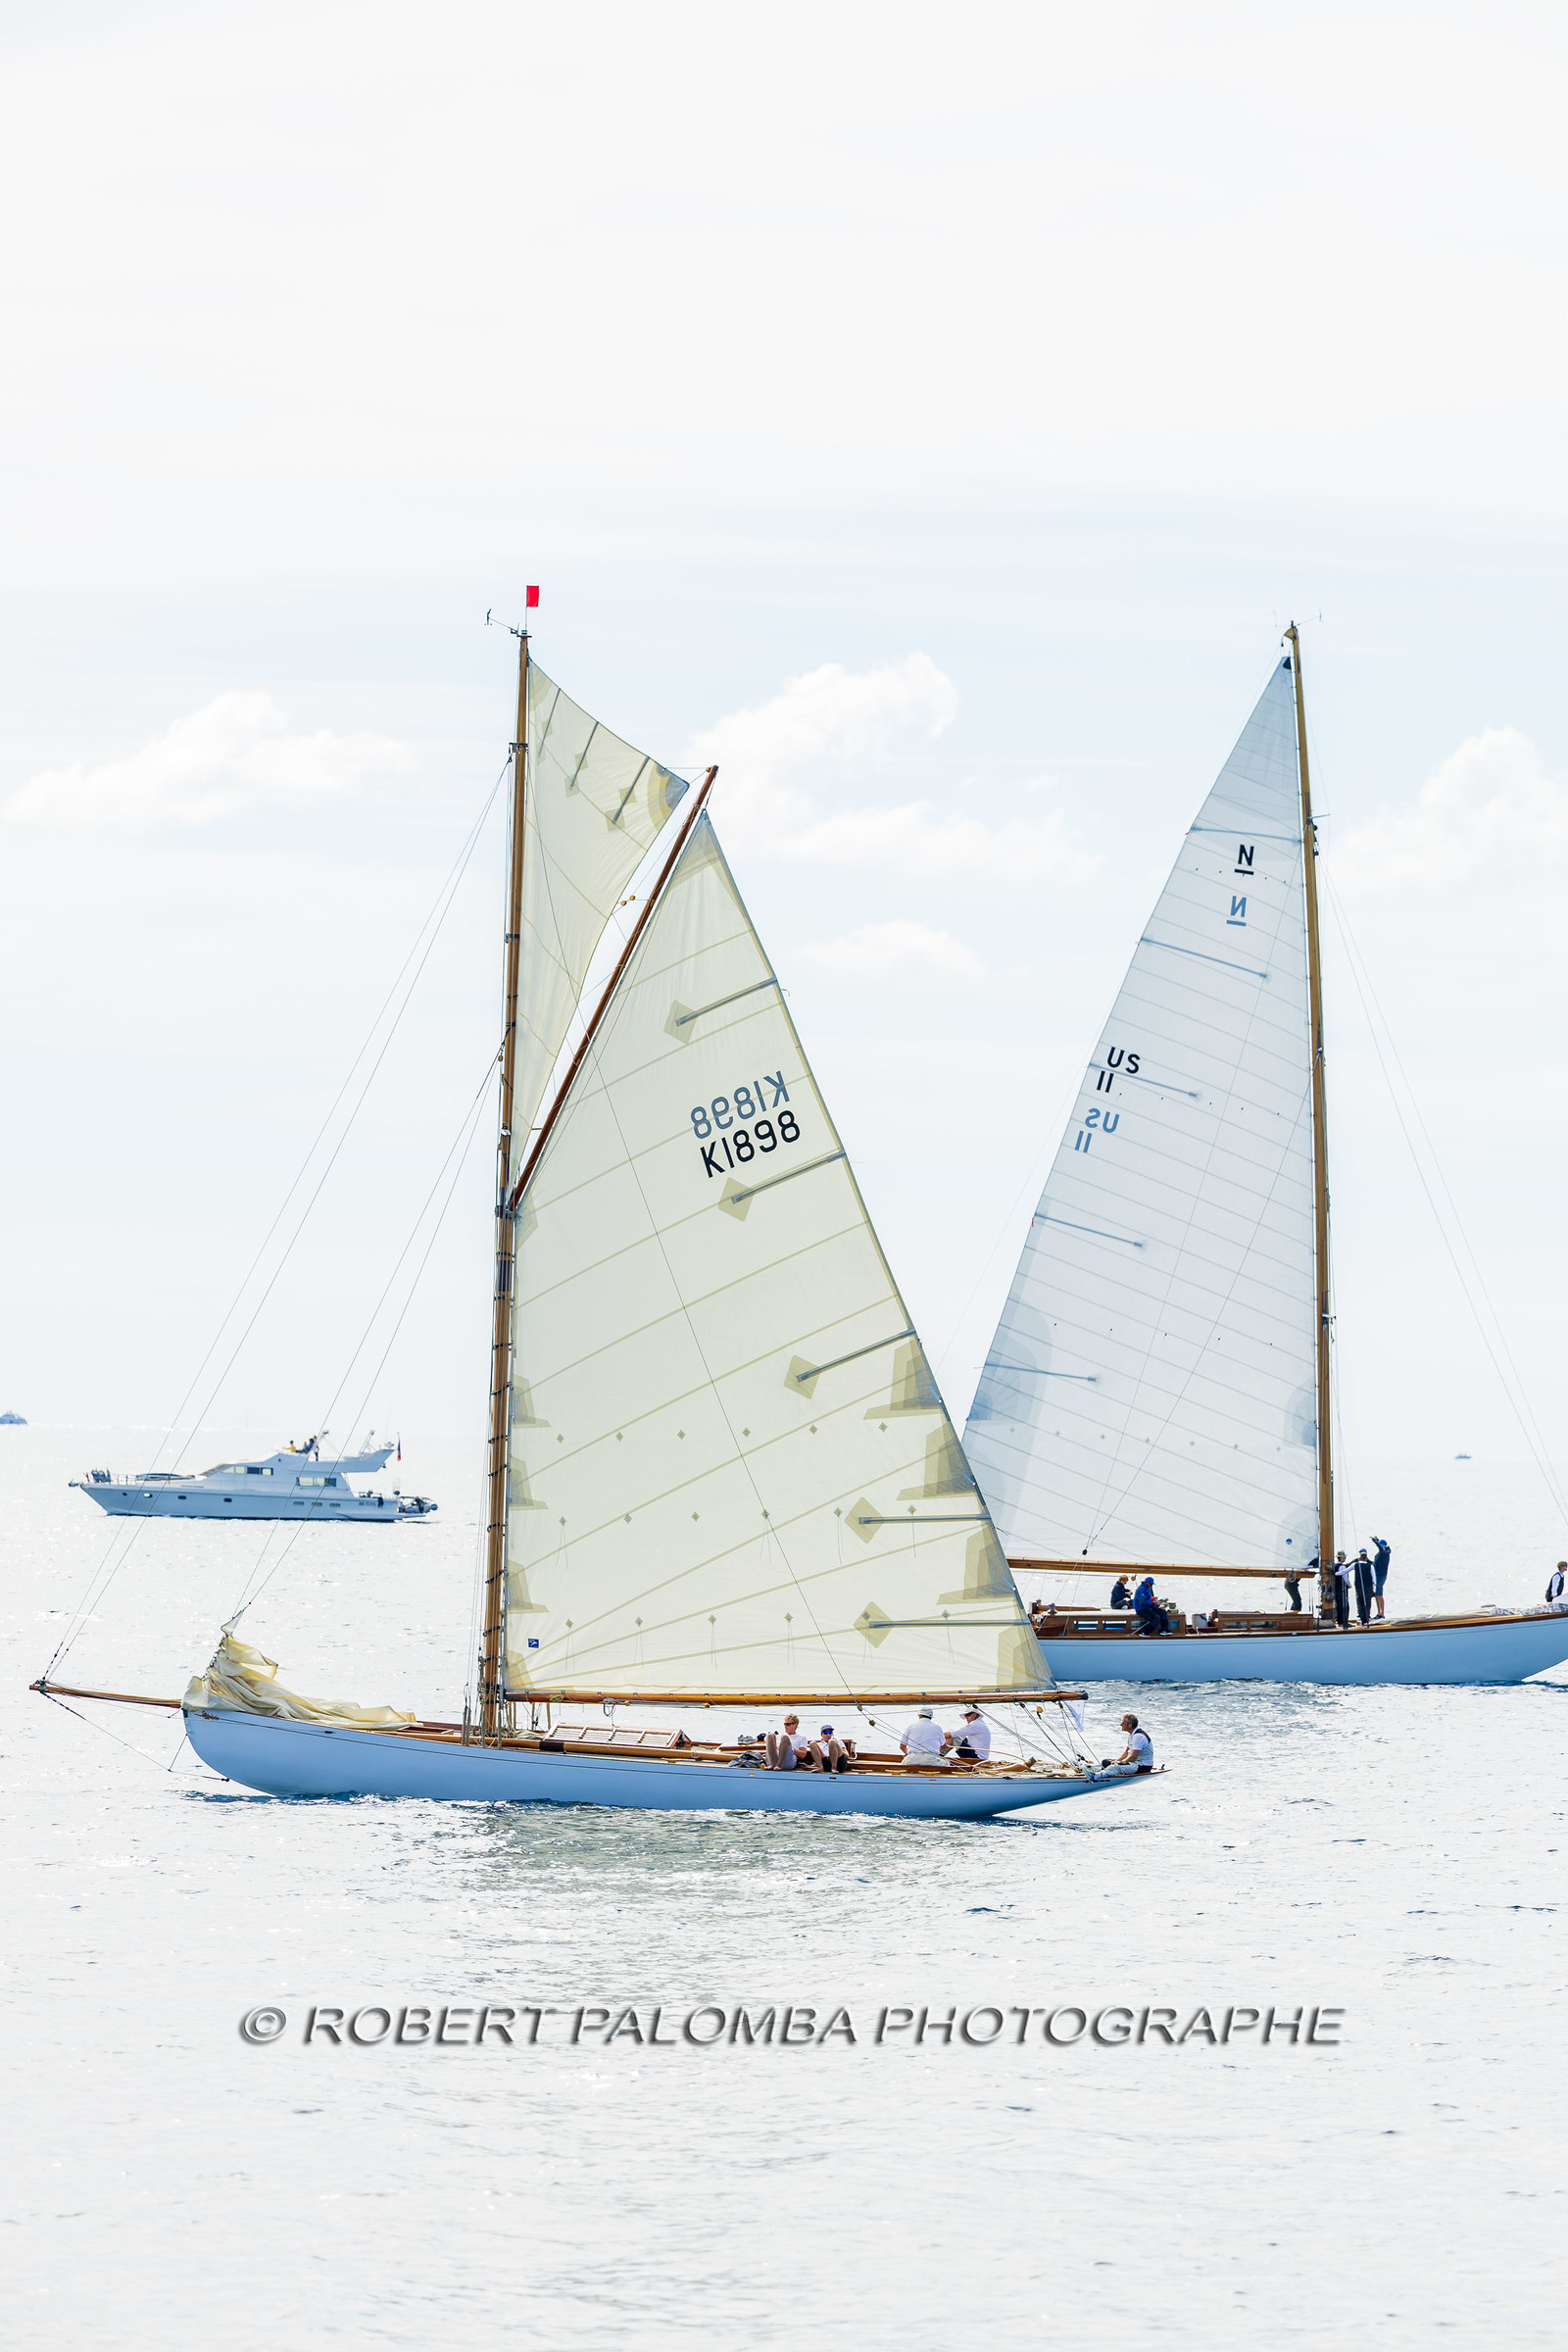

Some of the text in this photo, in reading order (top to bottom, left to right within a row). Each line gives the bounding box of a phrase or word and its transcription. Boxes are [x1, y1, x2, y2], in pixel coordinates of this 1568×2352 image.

[1237, 844, 1254, 867] N
[1106, 1046, 1141, 1074] US
[1096, 1070, 1114, 1094] 11
[700, 1109, 801, 1179] K1898
